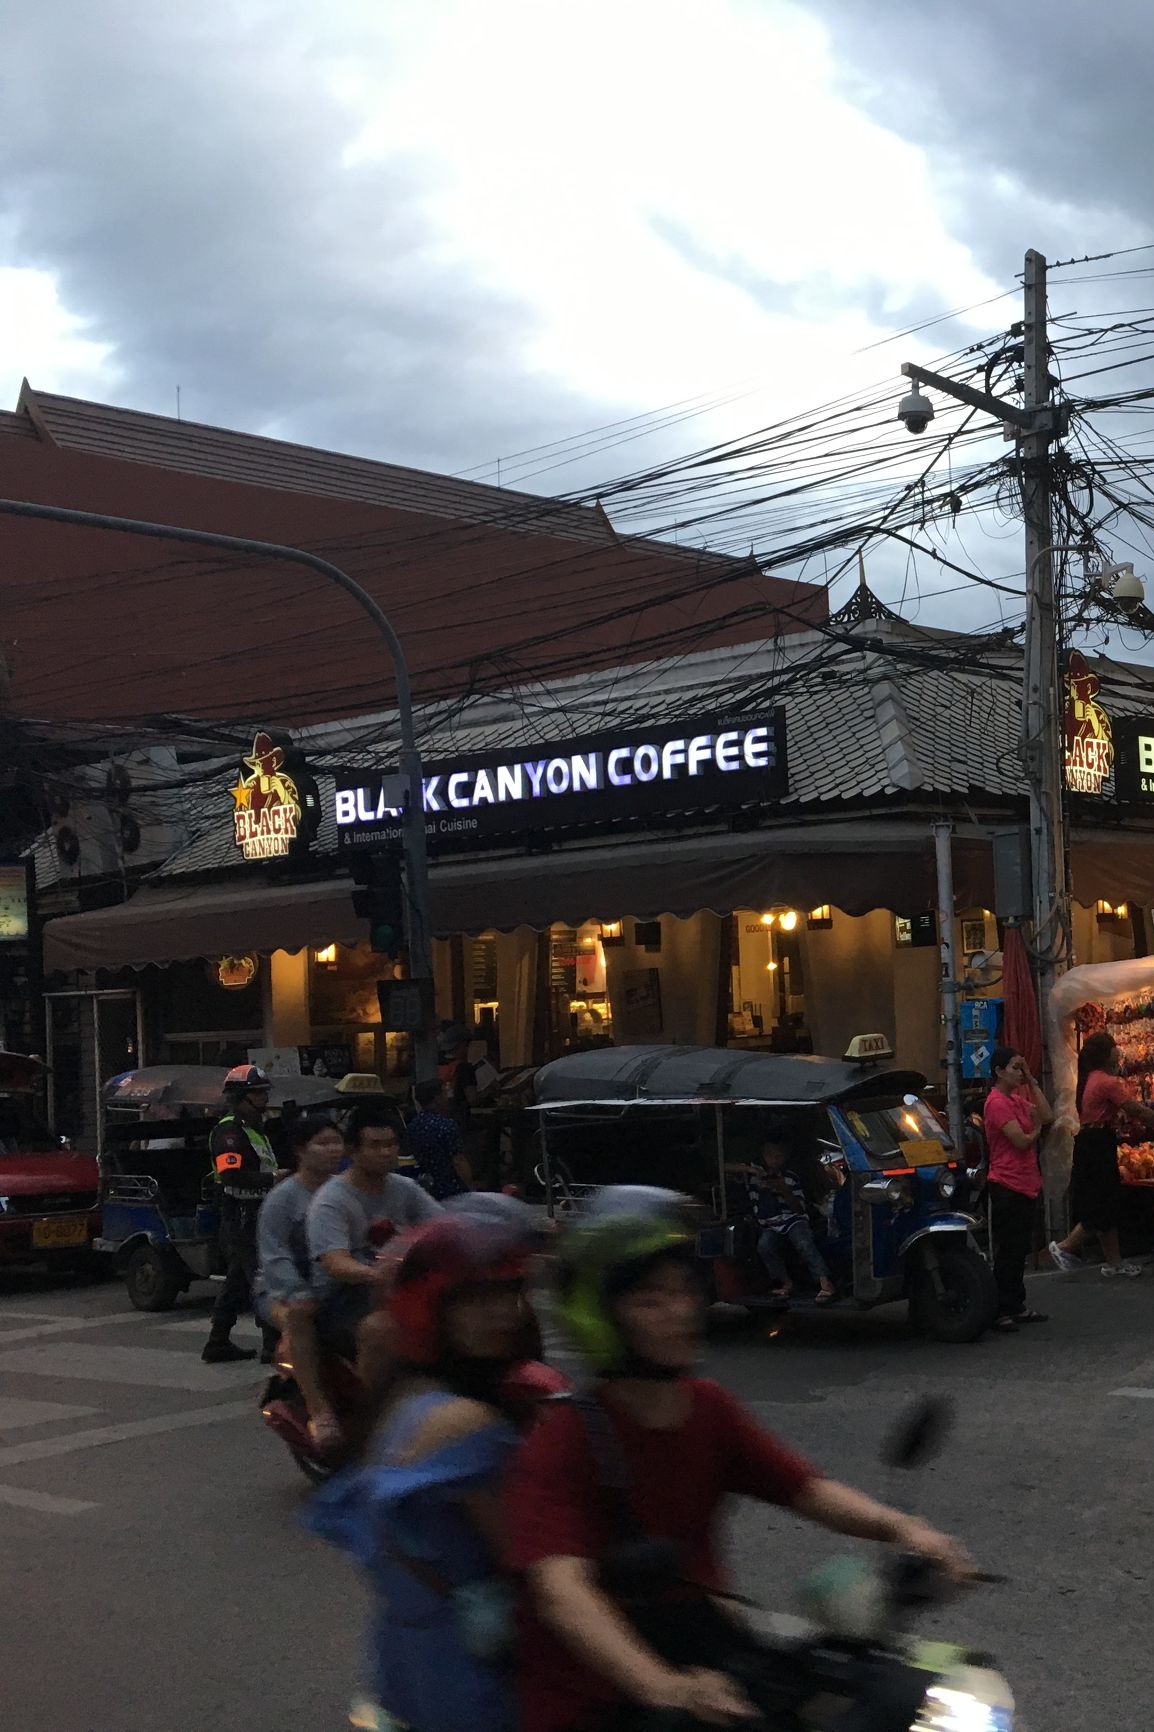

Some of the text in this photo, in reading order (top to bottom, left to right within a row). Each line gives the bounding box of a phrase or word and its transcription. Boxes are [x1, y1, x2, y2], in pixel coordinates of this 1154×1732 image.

[335, 726, 770, 824] BLAK CANYON COFFEE
[1140, 778, 1148, 791] &
[235, 804, 296, 844] BLACK
[343, 832, 352, 844] &
[440, 817, 478, 833] Cuisine
[243, 836, 289, 859] CANYON
[861, 1037, 885, 1052] TAXI
